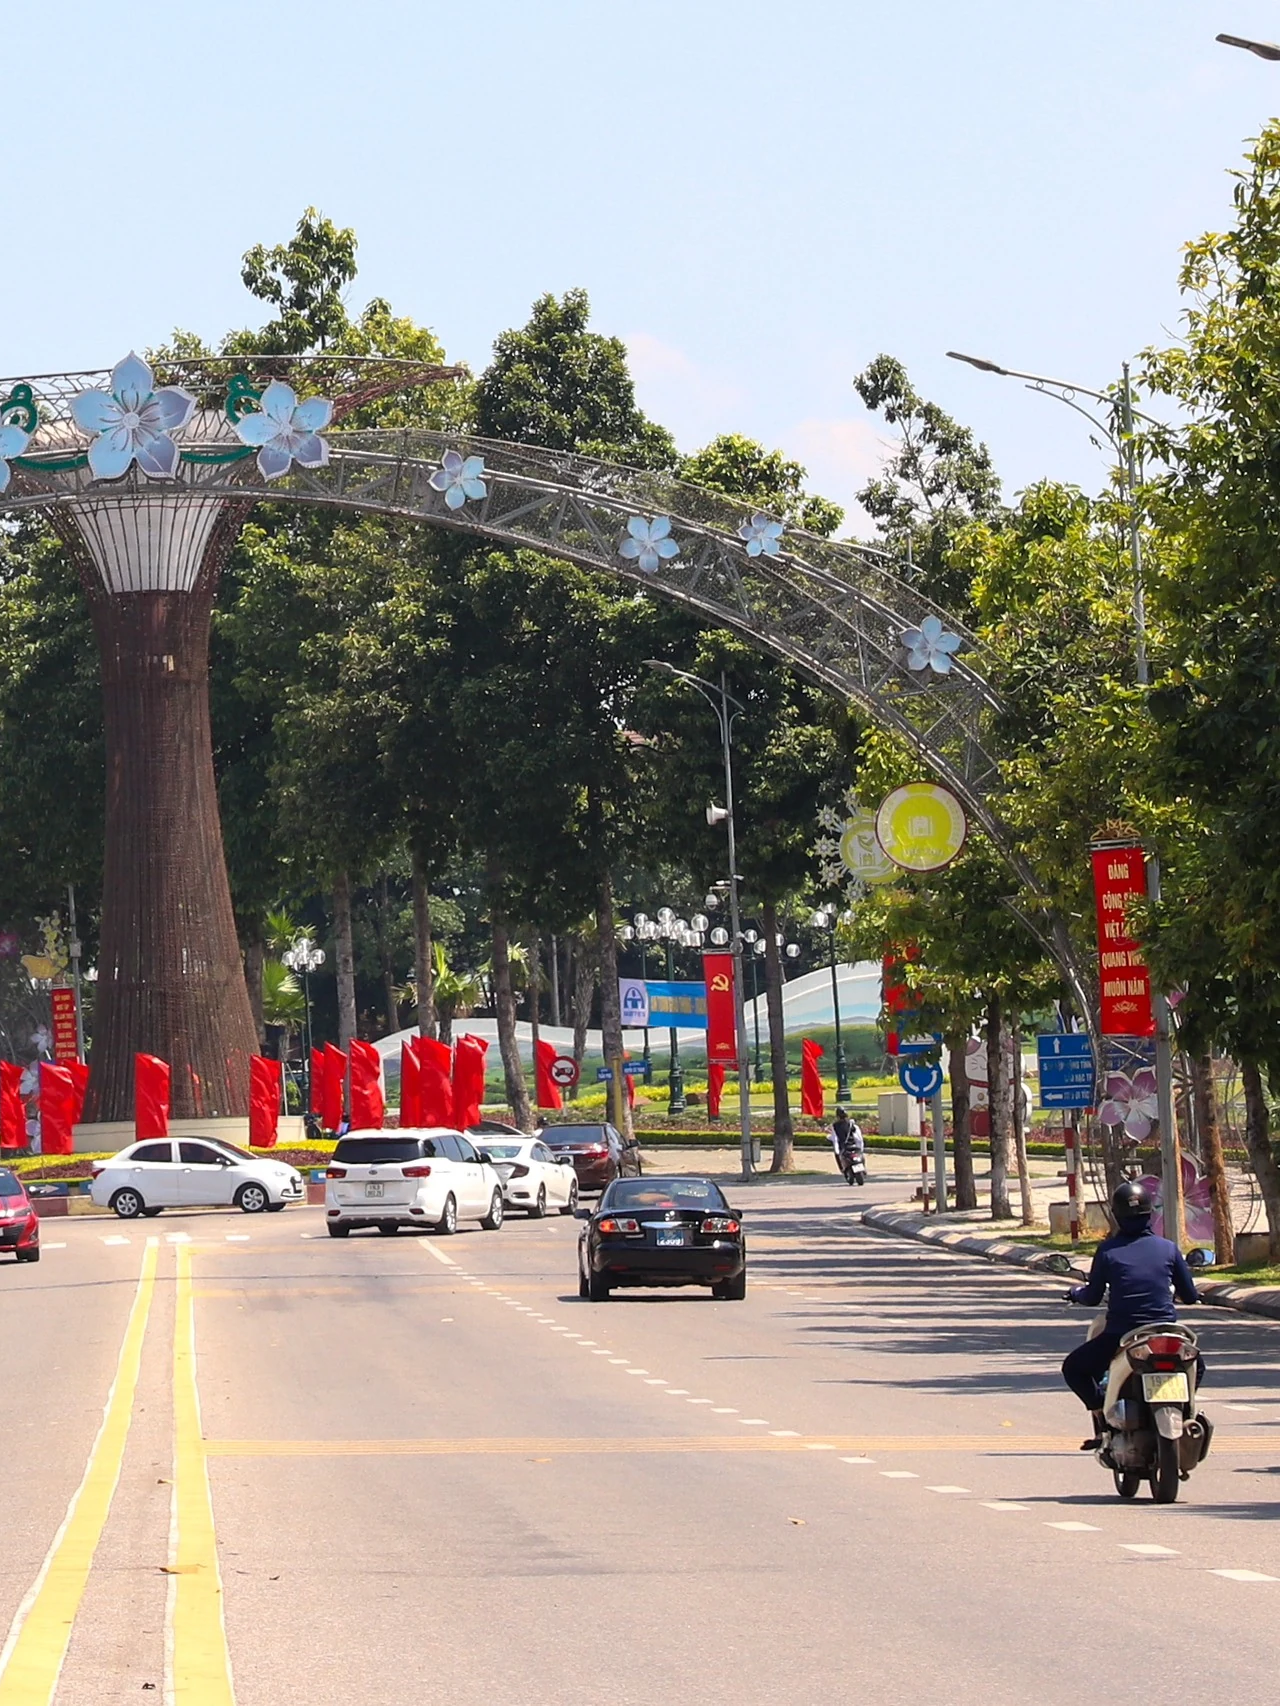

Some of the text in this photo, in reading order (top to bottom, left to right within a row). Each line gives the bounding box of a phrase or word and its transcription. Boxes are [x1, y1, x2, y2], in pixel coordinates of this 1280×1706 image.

[1108, 859, 1129, 880] ĐẢNG
[1103, 890, 1122, 912] CỘNG
[1105, 919, 1119, 941] VIỆT
[1102, 951, 1126, 969] QUANG
[1104, 976, 1145, 997] MUÔN NĂM
